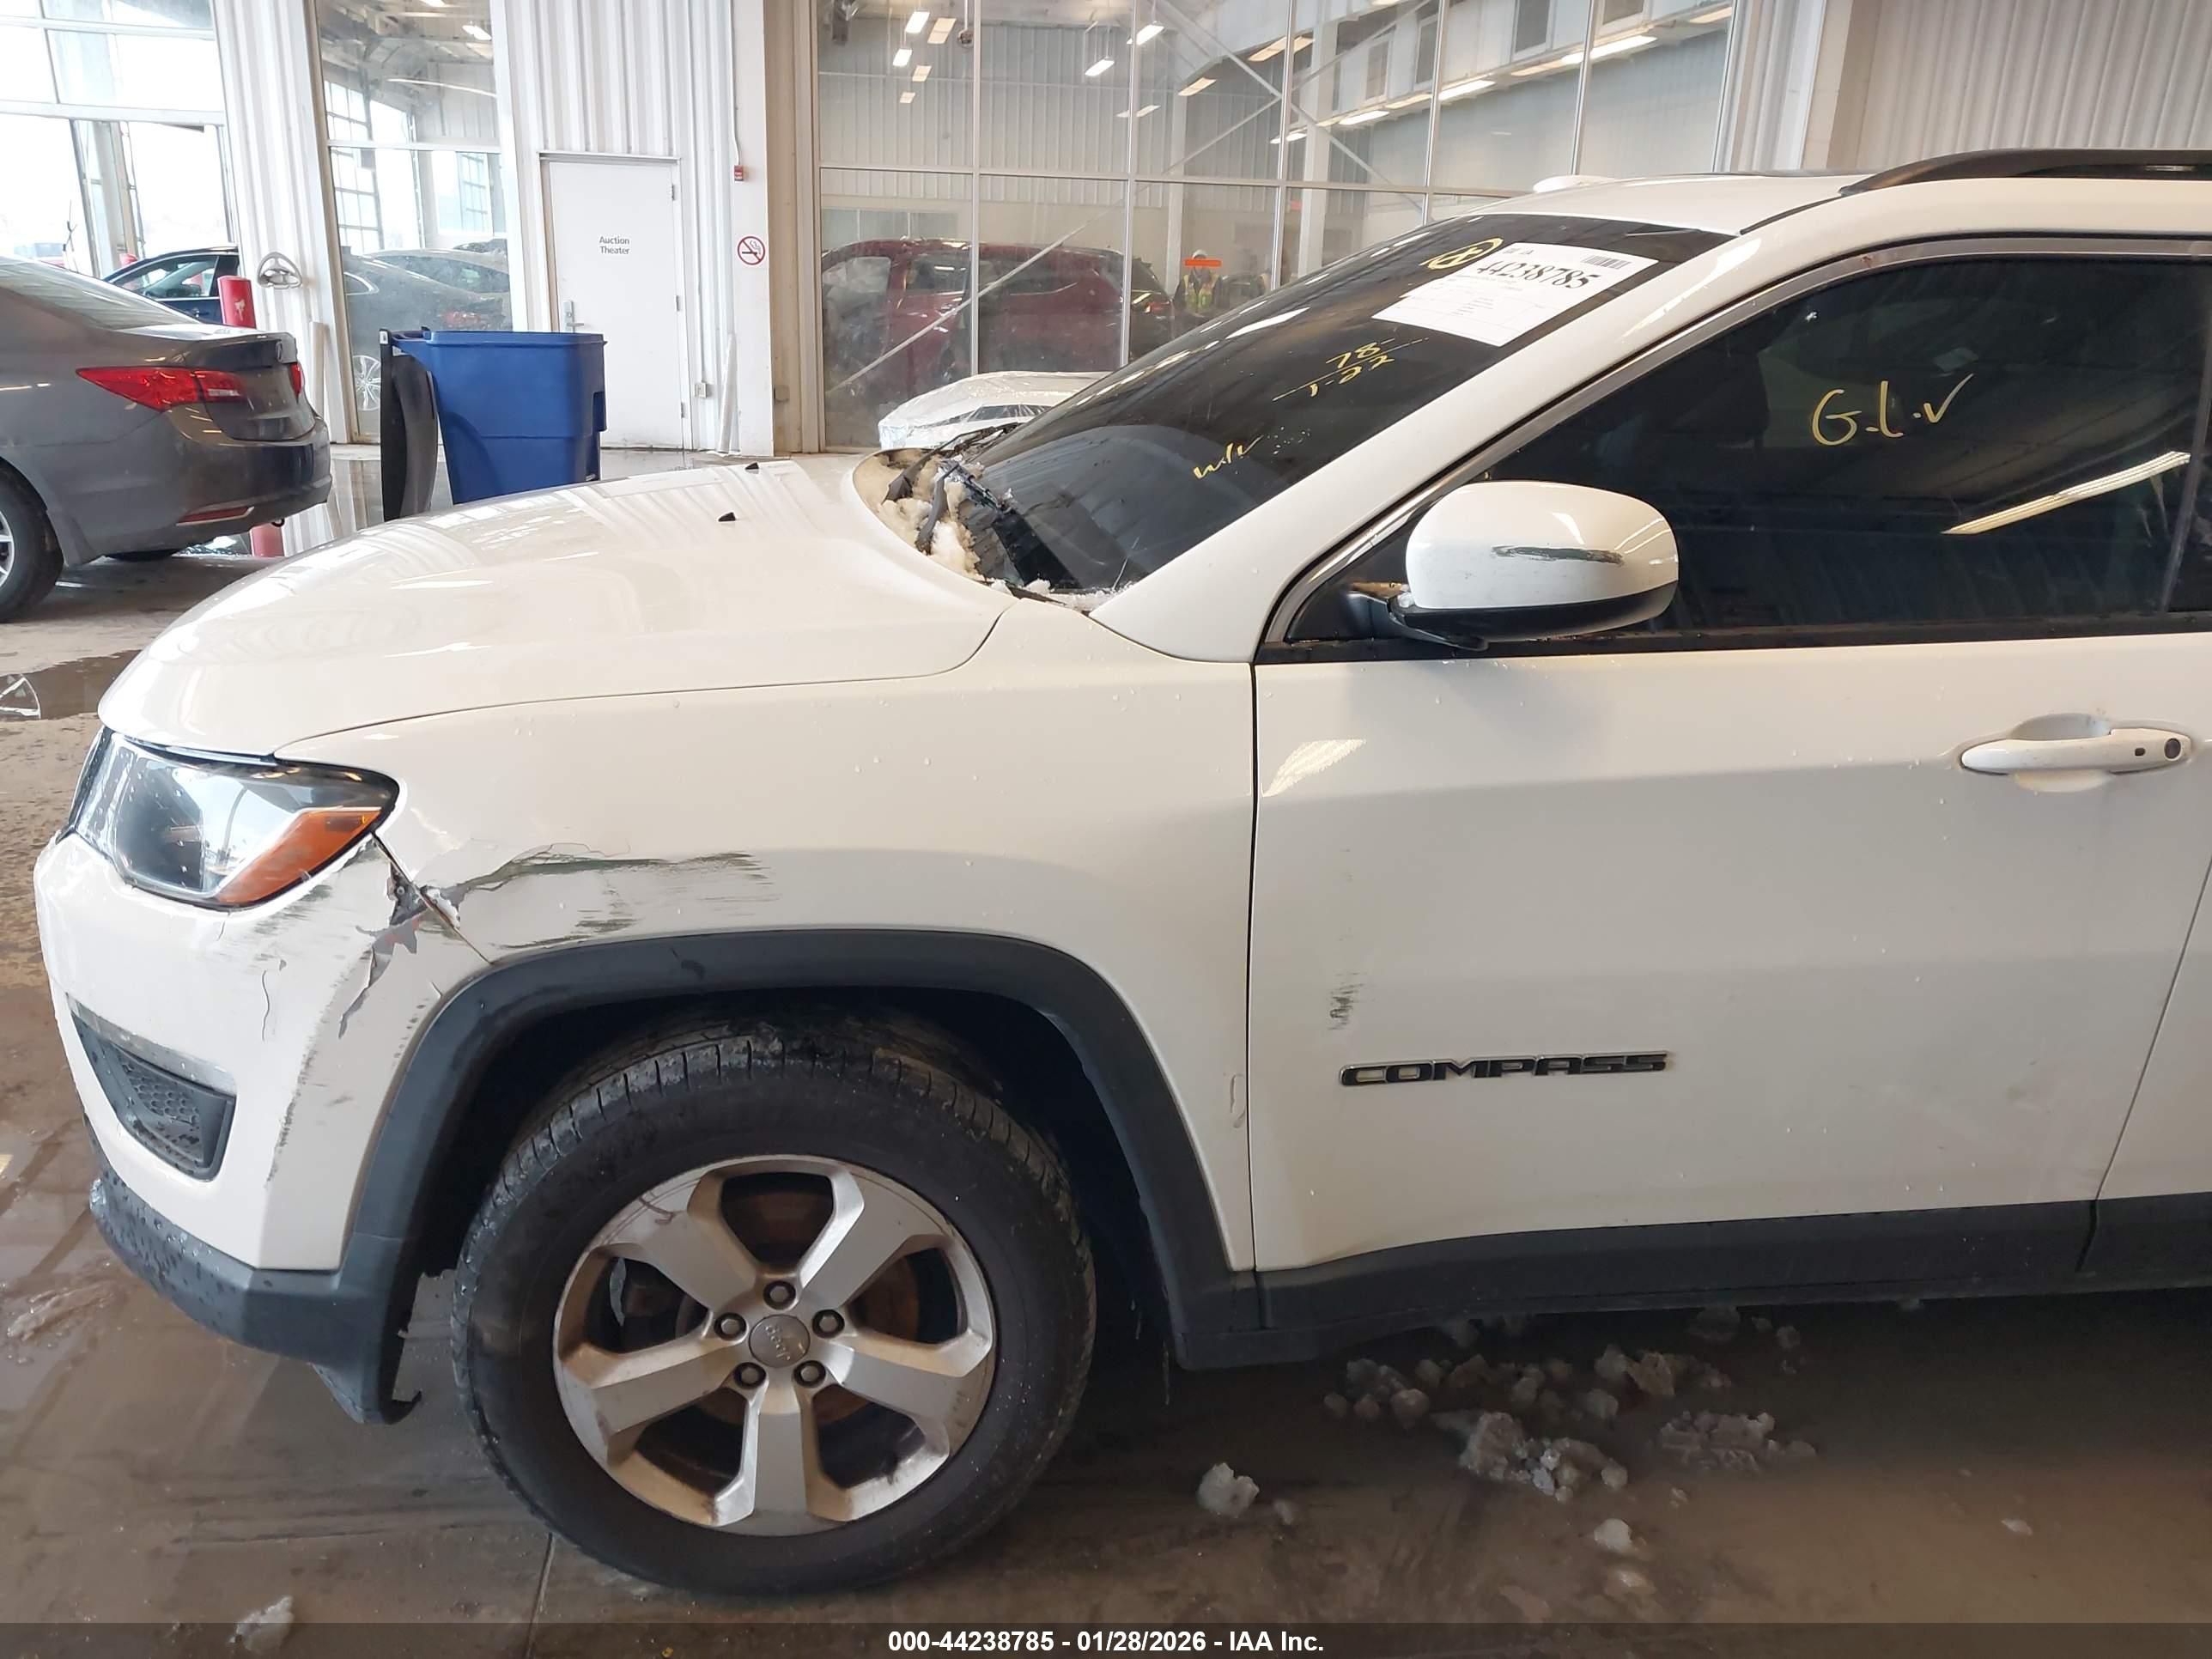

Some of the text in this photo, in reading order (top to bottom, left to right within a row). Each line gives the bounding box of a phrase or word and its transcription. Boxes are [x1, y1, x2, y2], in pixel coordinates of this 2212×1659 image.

[599, 235, 630, 245] Auction
[599, 246, 630, 255] Theater
[1476, 260, 1601, 289] 44238785
[1340, 1051, 1668, 1086] COMPASS
